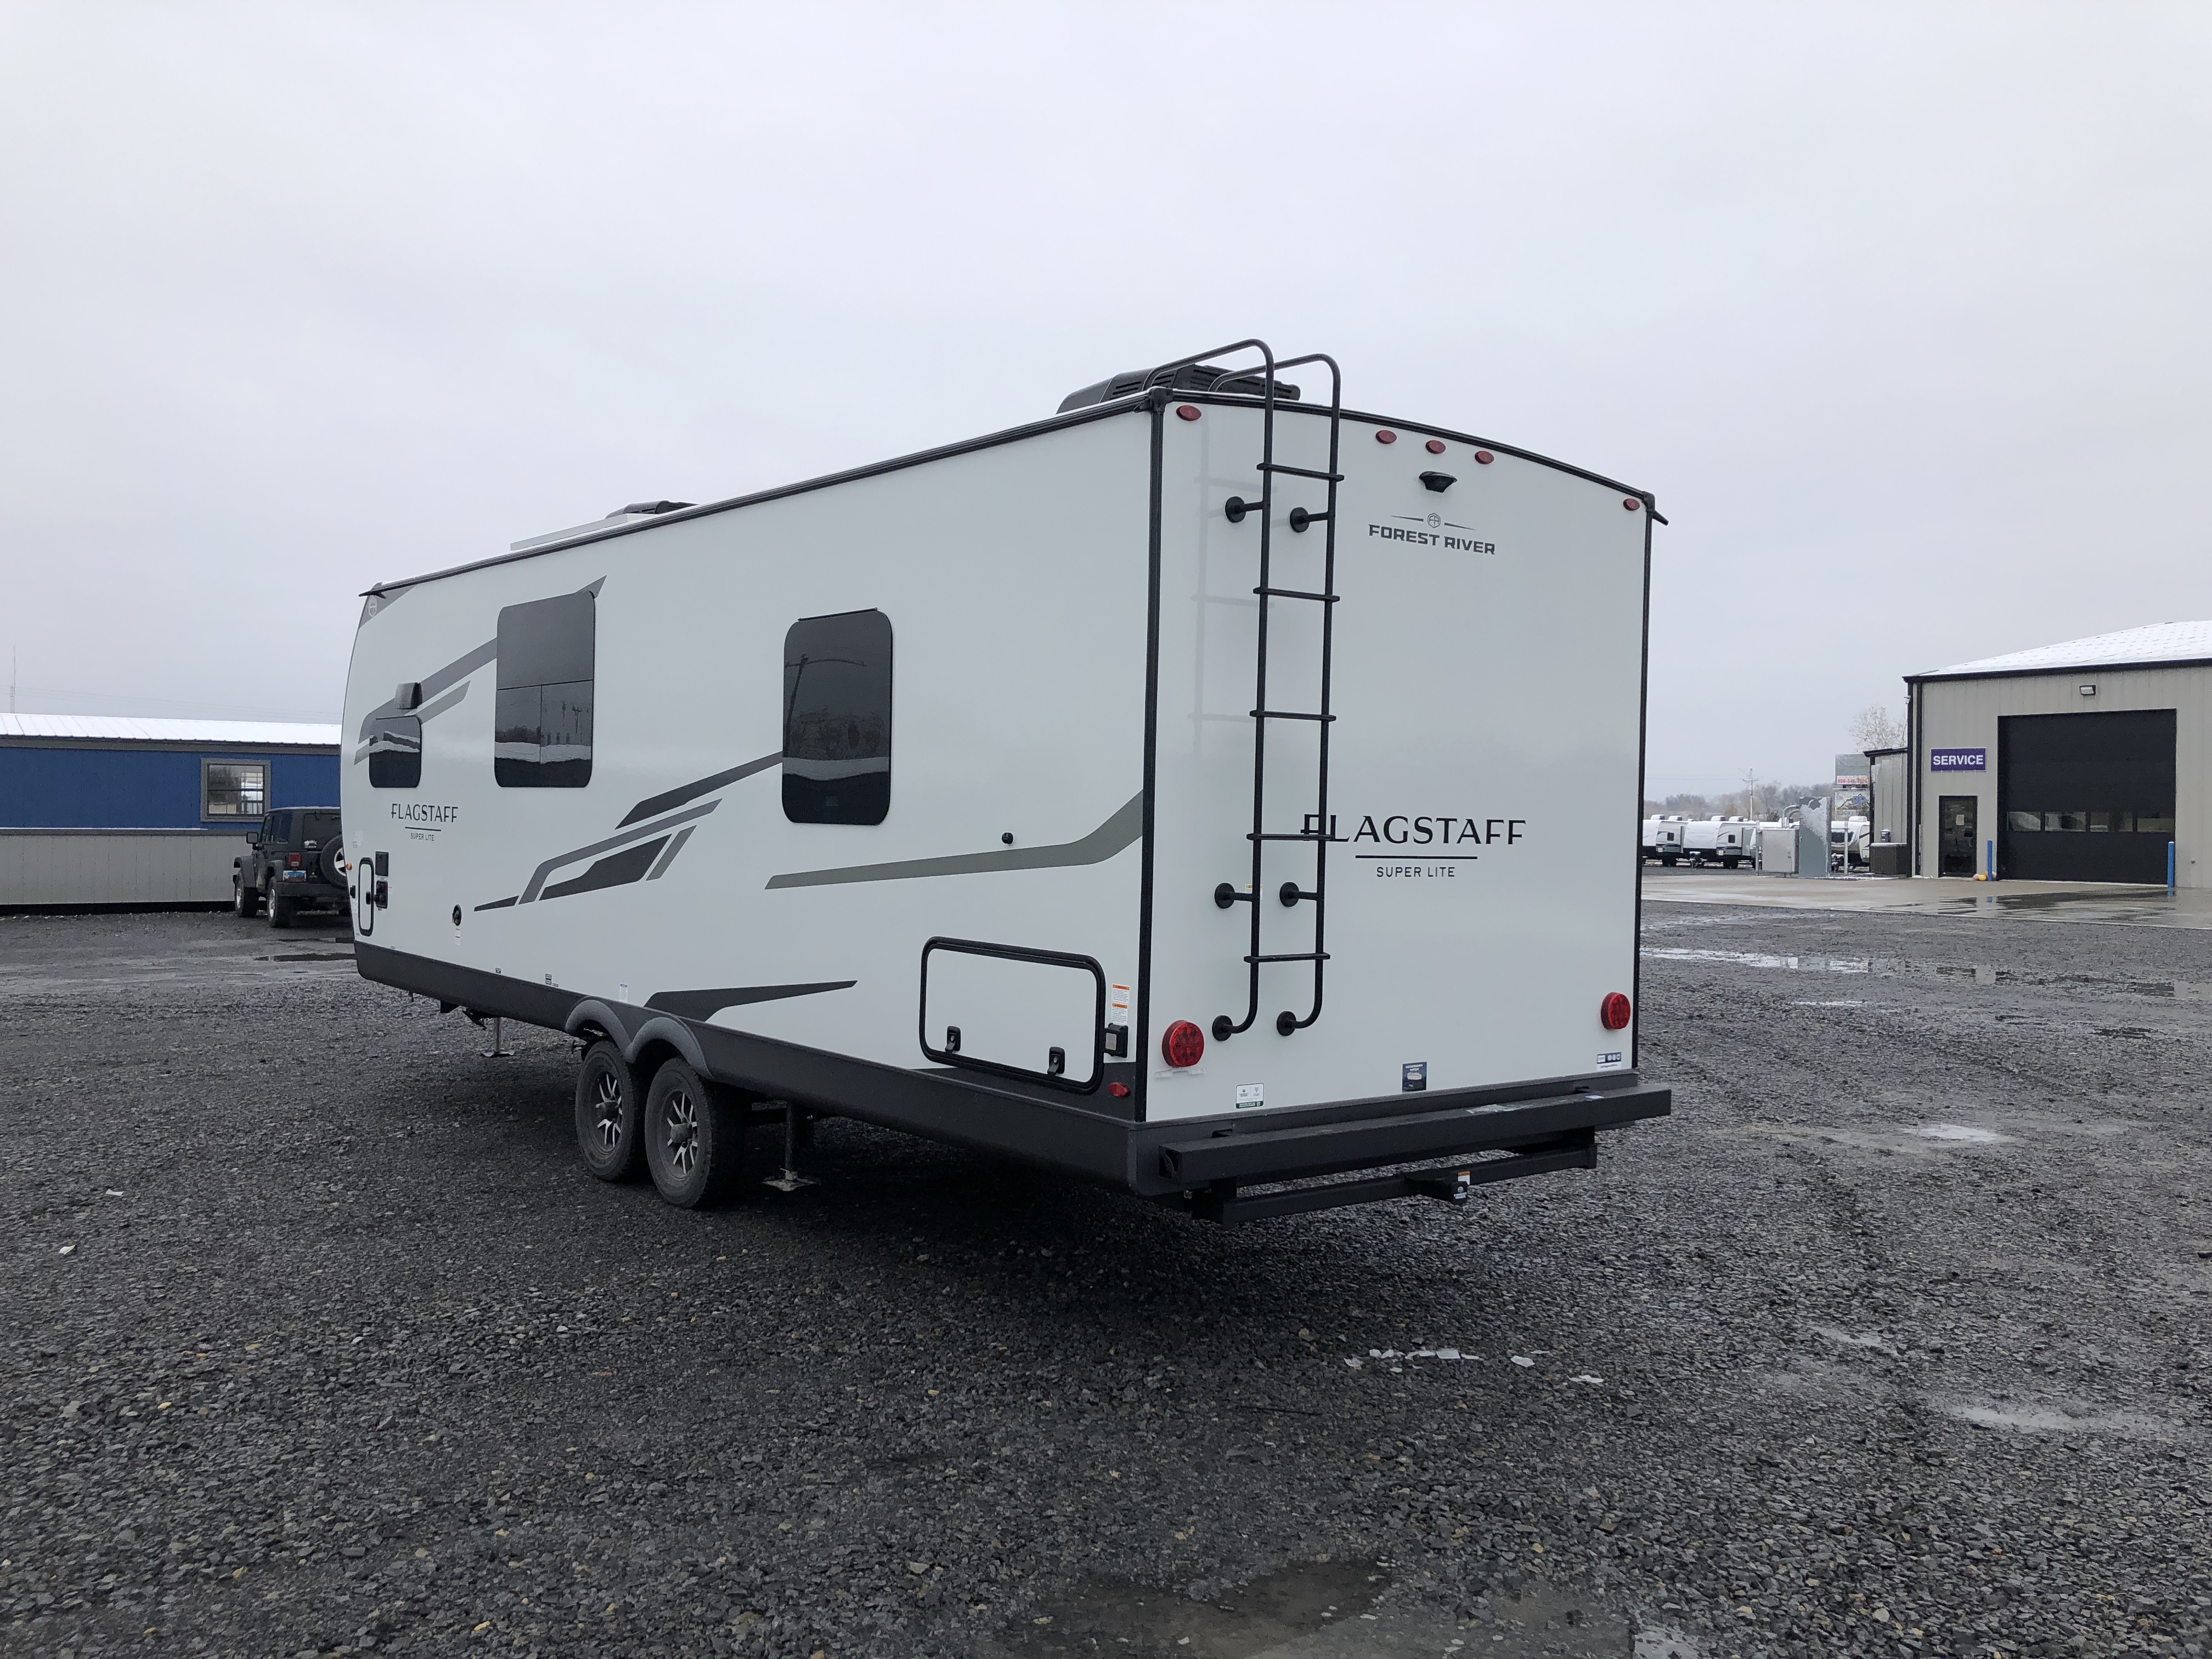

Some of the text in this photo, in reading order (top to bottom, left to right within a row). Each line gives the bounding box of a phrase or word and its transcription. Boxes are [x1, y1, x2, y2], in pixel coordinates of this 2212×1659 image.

[1368, 523, 1496, 555] FOREST RIVER
[1933, 754, 1984, 765] SERVICE
[391, 803, 459, 823] FLAGSTAFF
[410, 832, 435, 842] SUPER LITE
[1300, 814, 1527, 845] FLAGSTAFF
[1376, 866, 1455, 878] SUPER LITE
